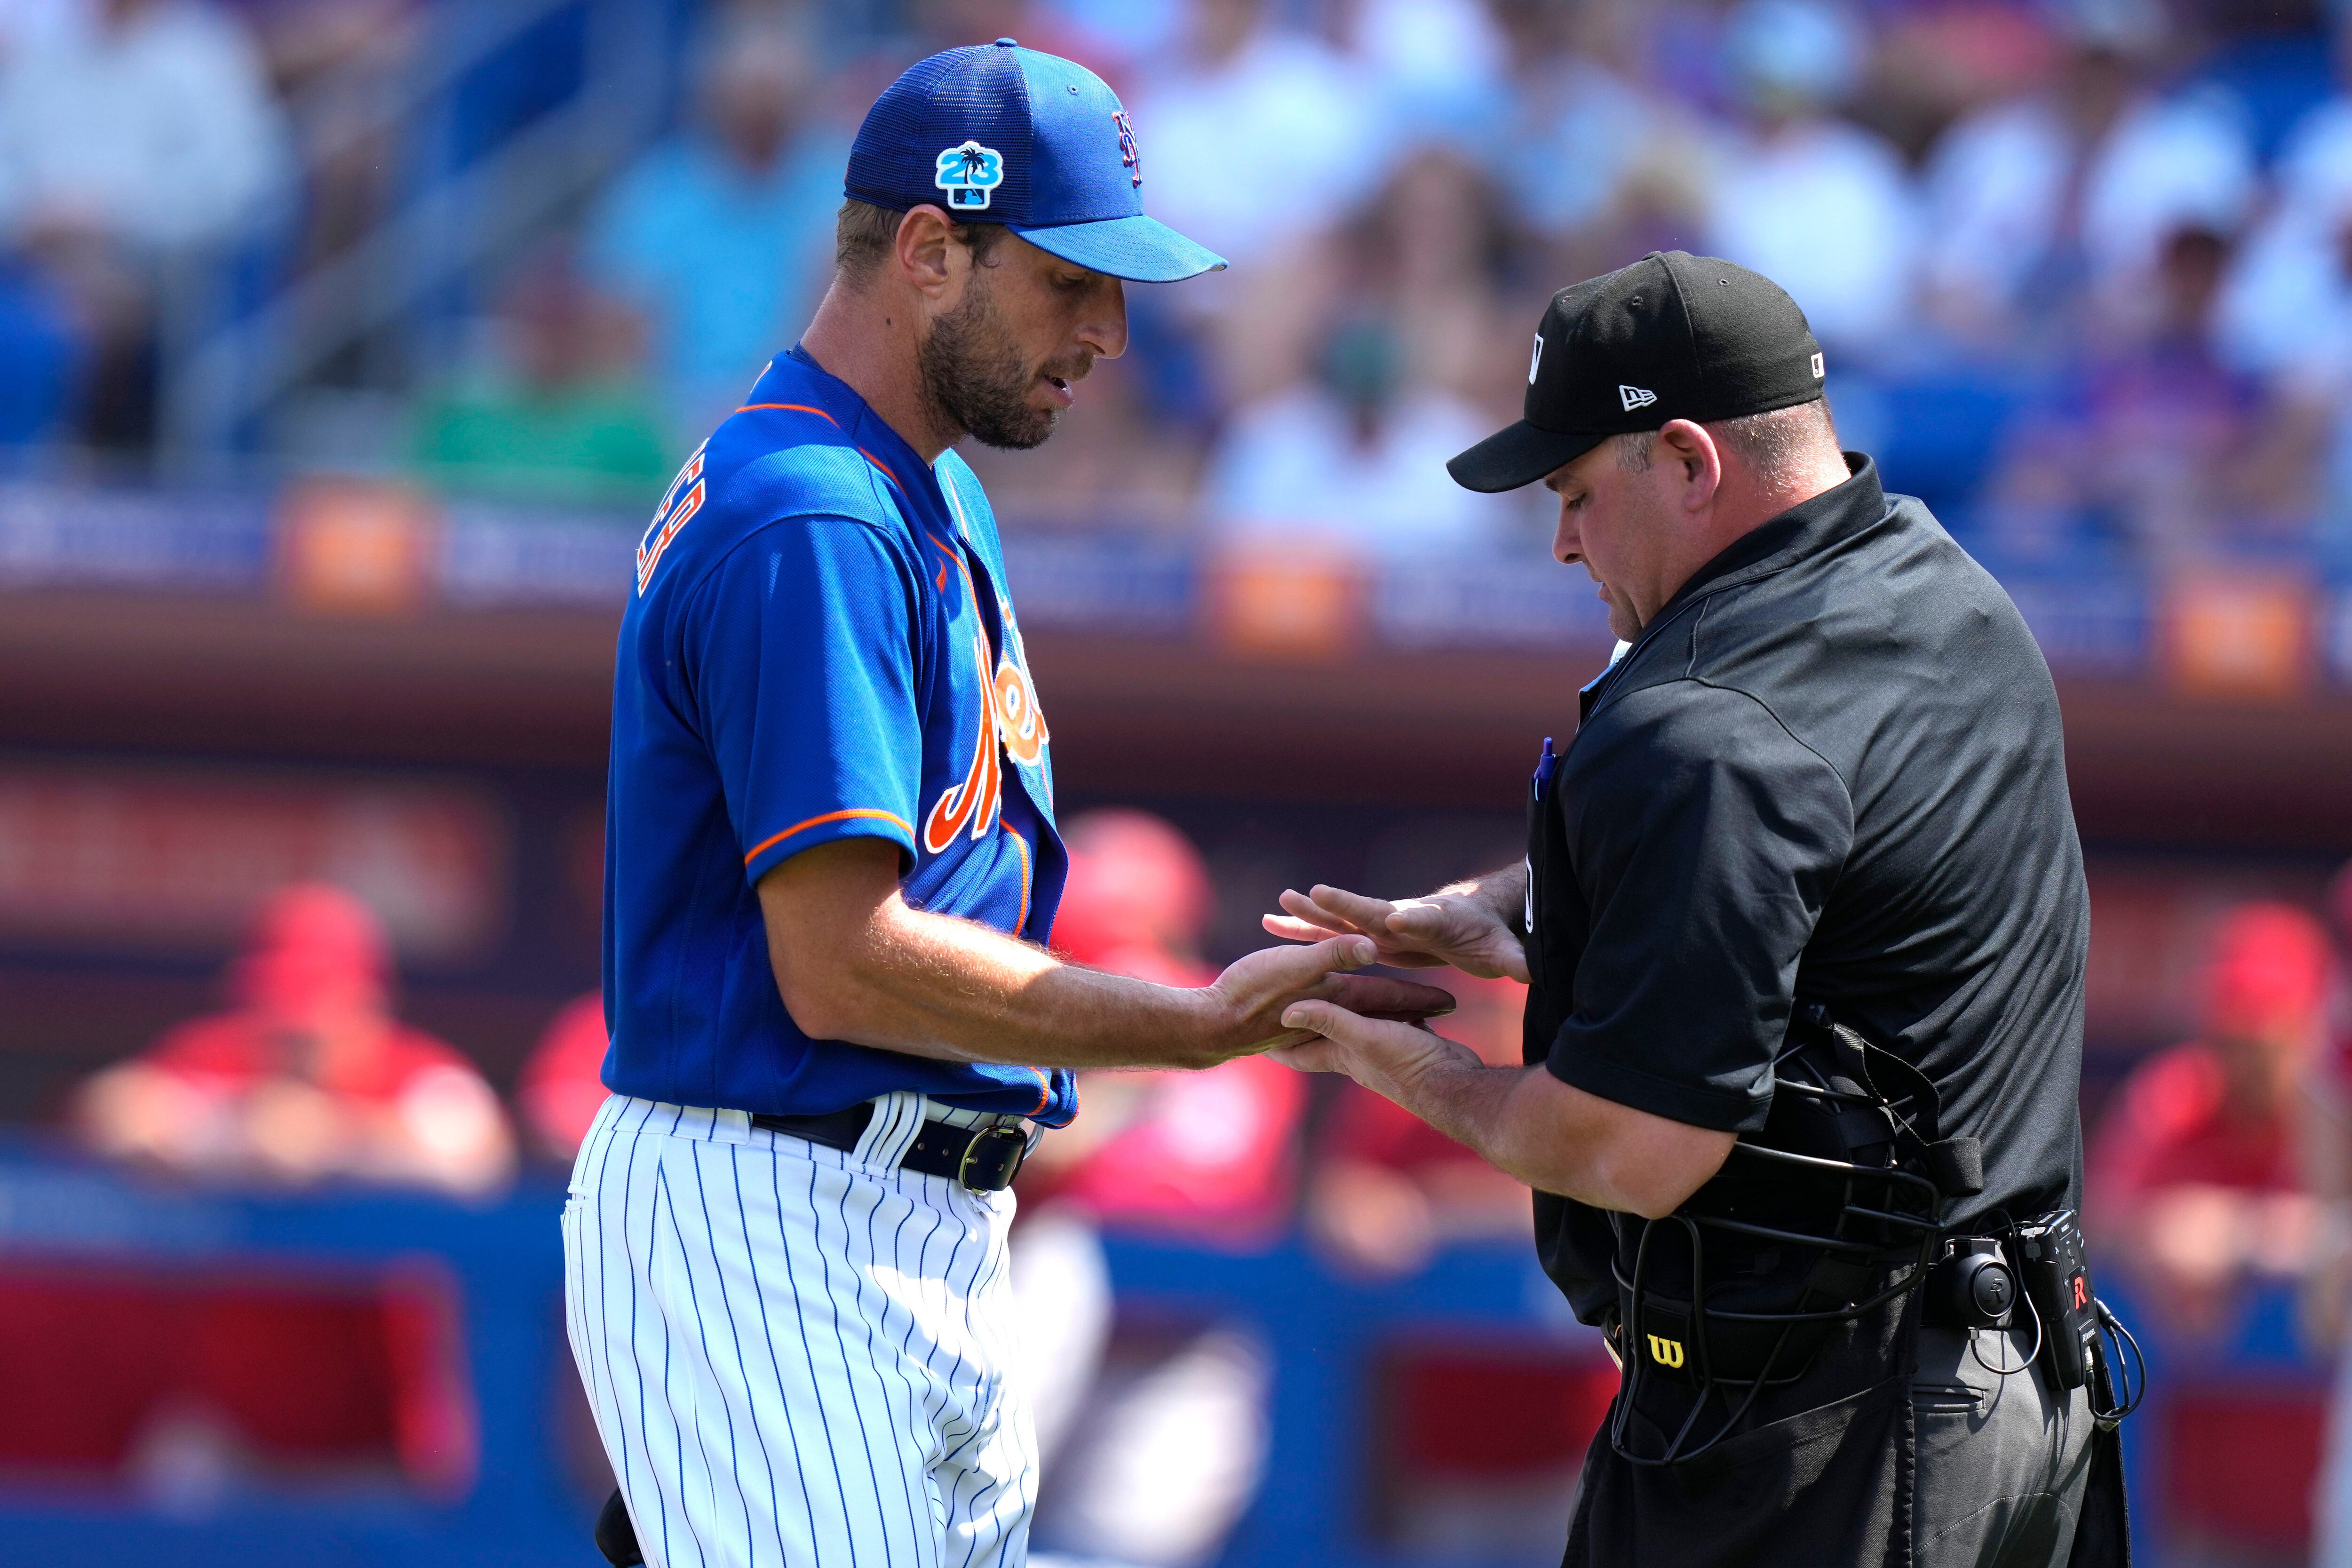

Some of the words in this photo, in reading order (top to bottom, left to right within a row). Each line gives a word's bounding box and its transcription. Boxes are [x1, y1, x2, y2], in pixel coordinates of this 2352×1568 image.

[940, 153, 998, 185] 23
[637, 438, 709, 598] ER
[2074, 1276, 2087, 1310] R
